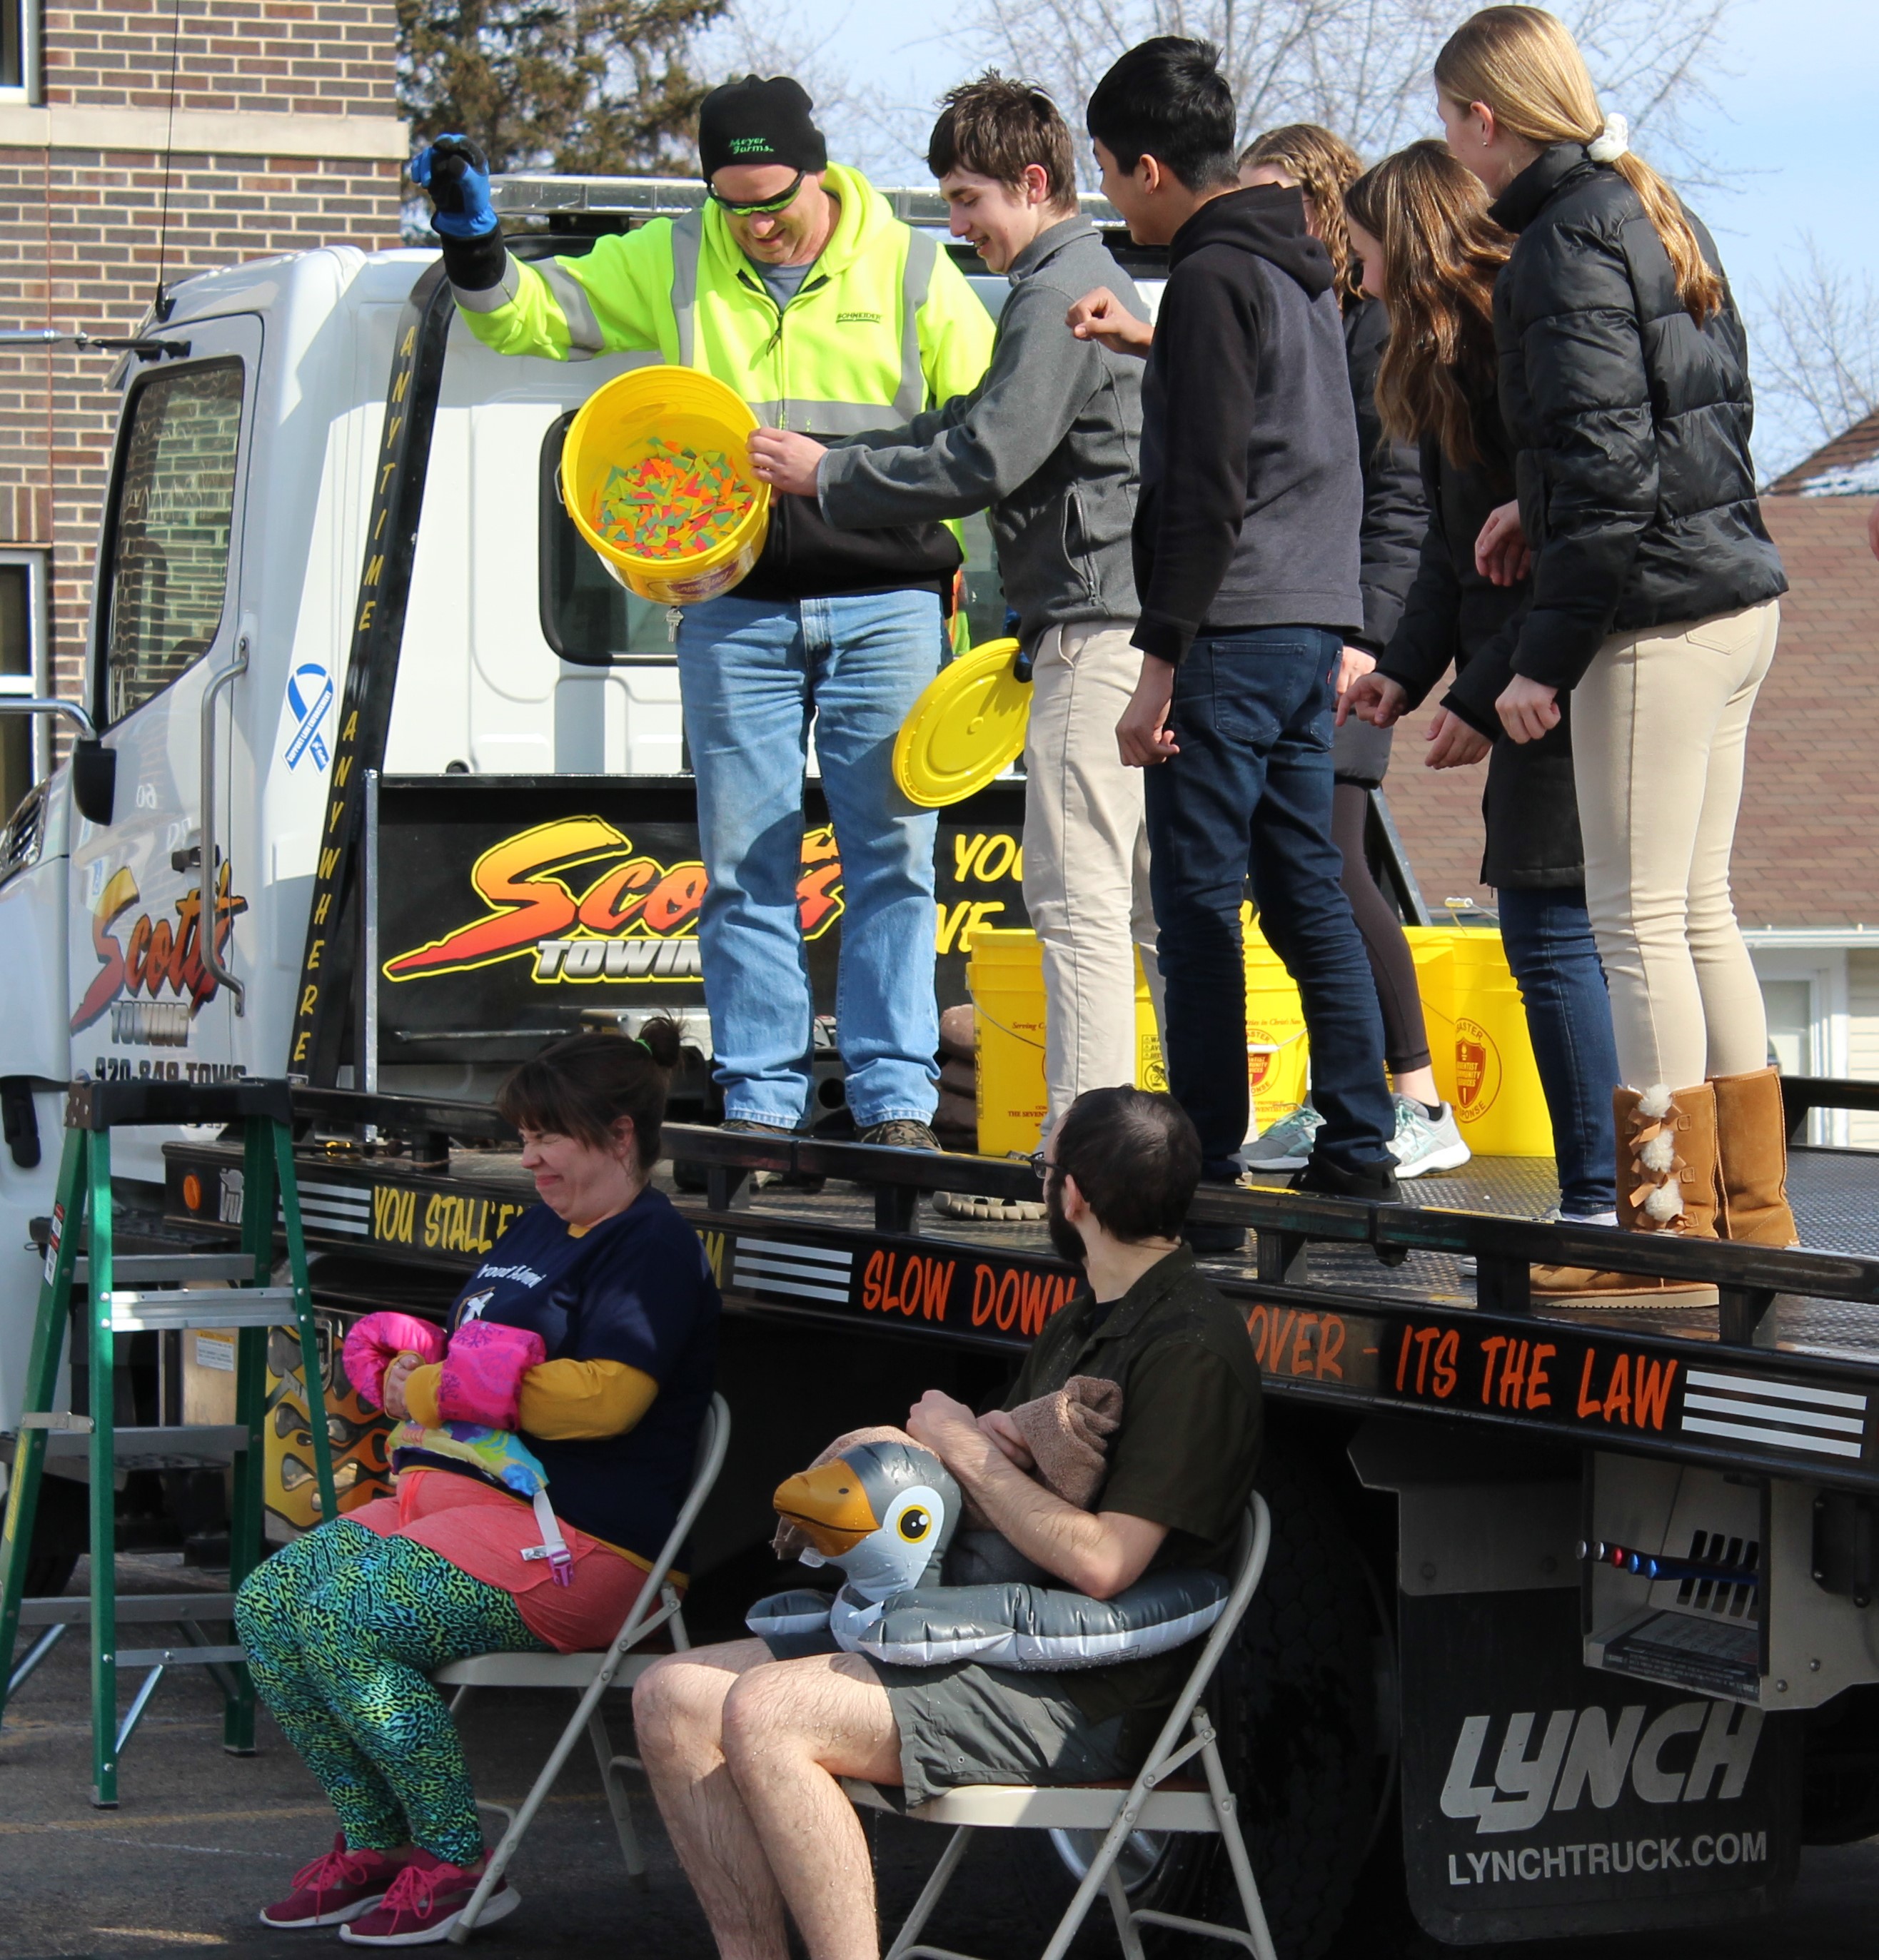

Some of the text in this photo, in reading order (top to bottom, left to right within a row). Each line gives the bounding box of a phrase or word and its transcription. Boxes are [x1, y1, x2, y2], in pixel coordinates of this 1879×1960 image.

[729, 138, 765, 147] Meyer
[358, 325, 415, 632] ANYTIME
[286, 734, 304, 762] SUPPORT
[301, 726, 312, 739] LAW
[307, 690, 332, 728] ENFORCEMENT
[293, 711, 358, 1061] ANYWHERE
[1012, 1022, 1036, 1031] Serving
[374, 1186, 523, 1255] YOU STALL'E
[863, 1250, 955, 1321] SLOW
[1246, 1305, 1346, 1380] OVER
[1396, 1324, 1460, 1398] ITS
[1481, 1335, 1556, 1410] THE
[1577, 1348, 1678, 1431] LAW
[1440, 1701, 1766, 1834] LYNCH
[1448, 1831, 1768, 1886] LYNCHTRUCK.COM
